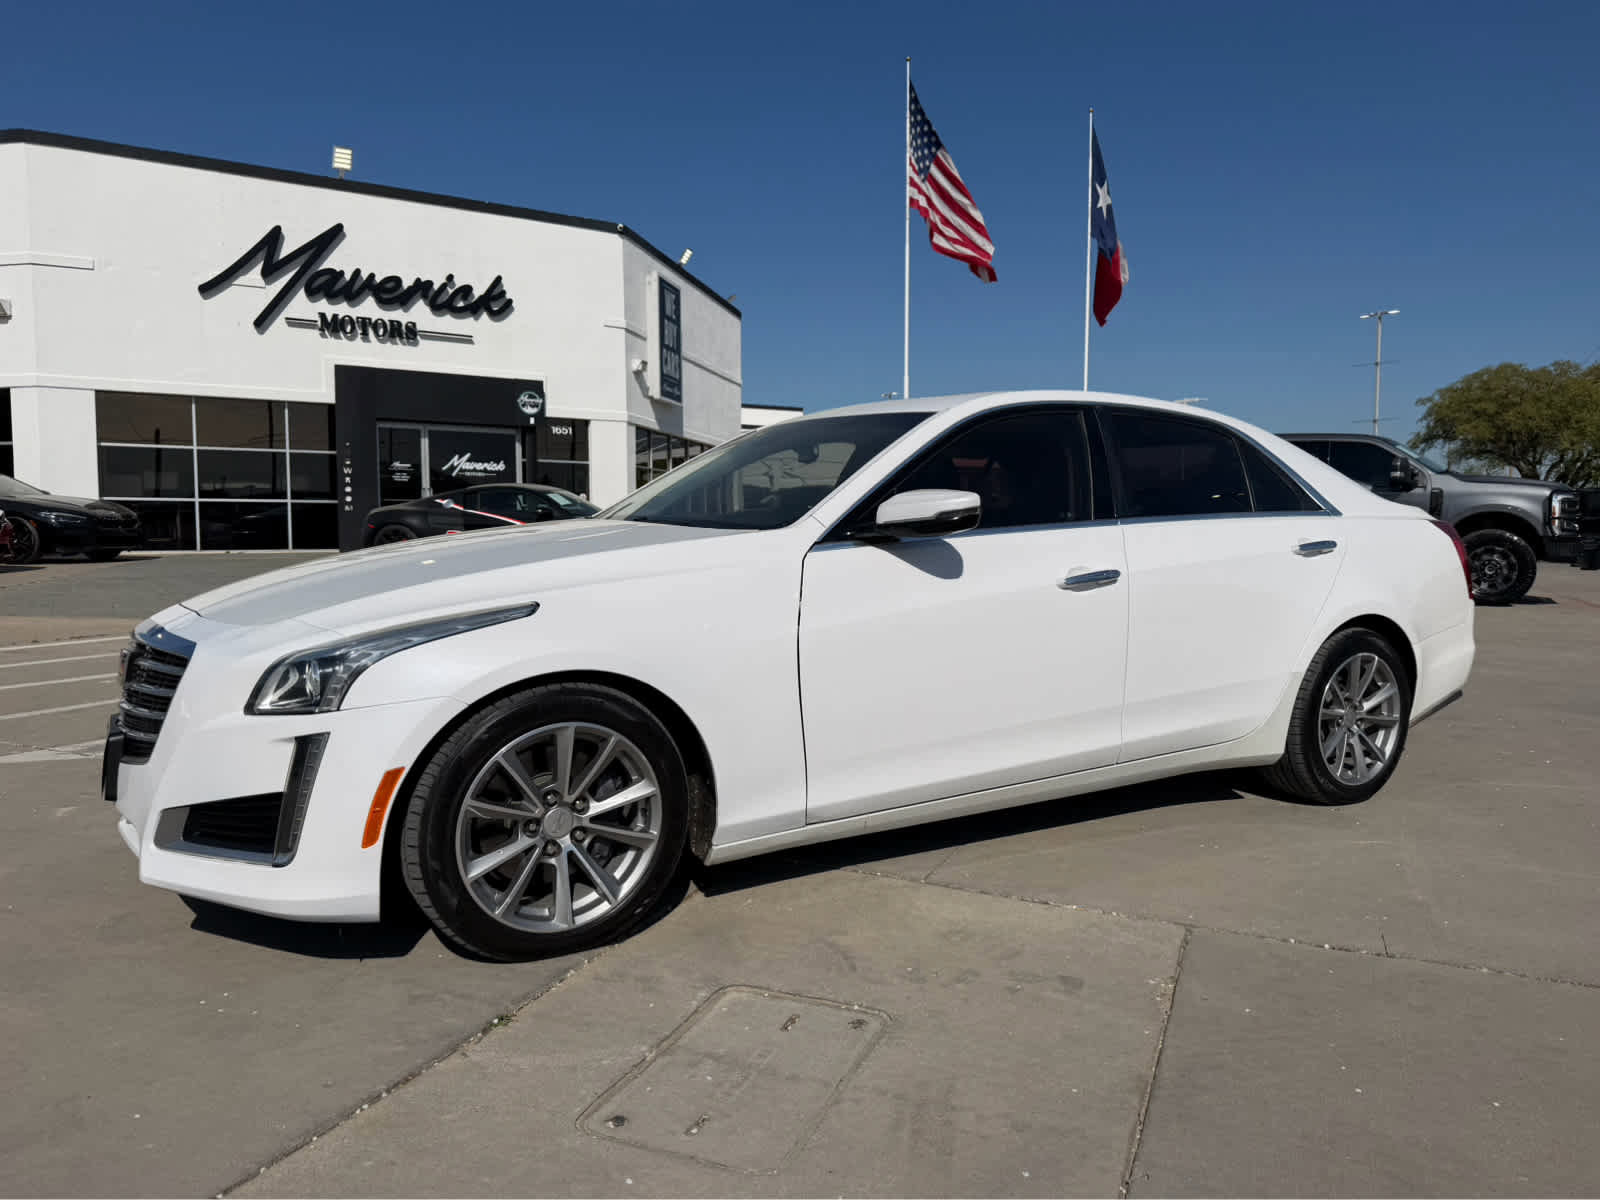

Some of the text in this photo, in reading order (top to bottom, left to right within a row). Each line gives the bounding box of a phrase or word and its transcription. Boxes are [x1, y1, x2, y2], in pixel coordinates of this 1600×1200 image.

[198, 223, 514, 331] Maverick
[318, 312, 420, 344] MOTORS
[552, 426, 573, 435] 1651
[442, 453, 506, 477] Maverick
